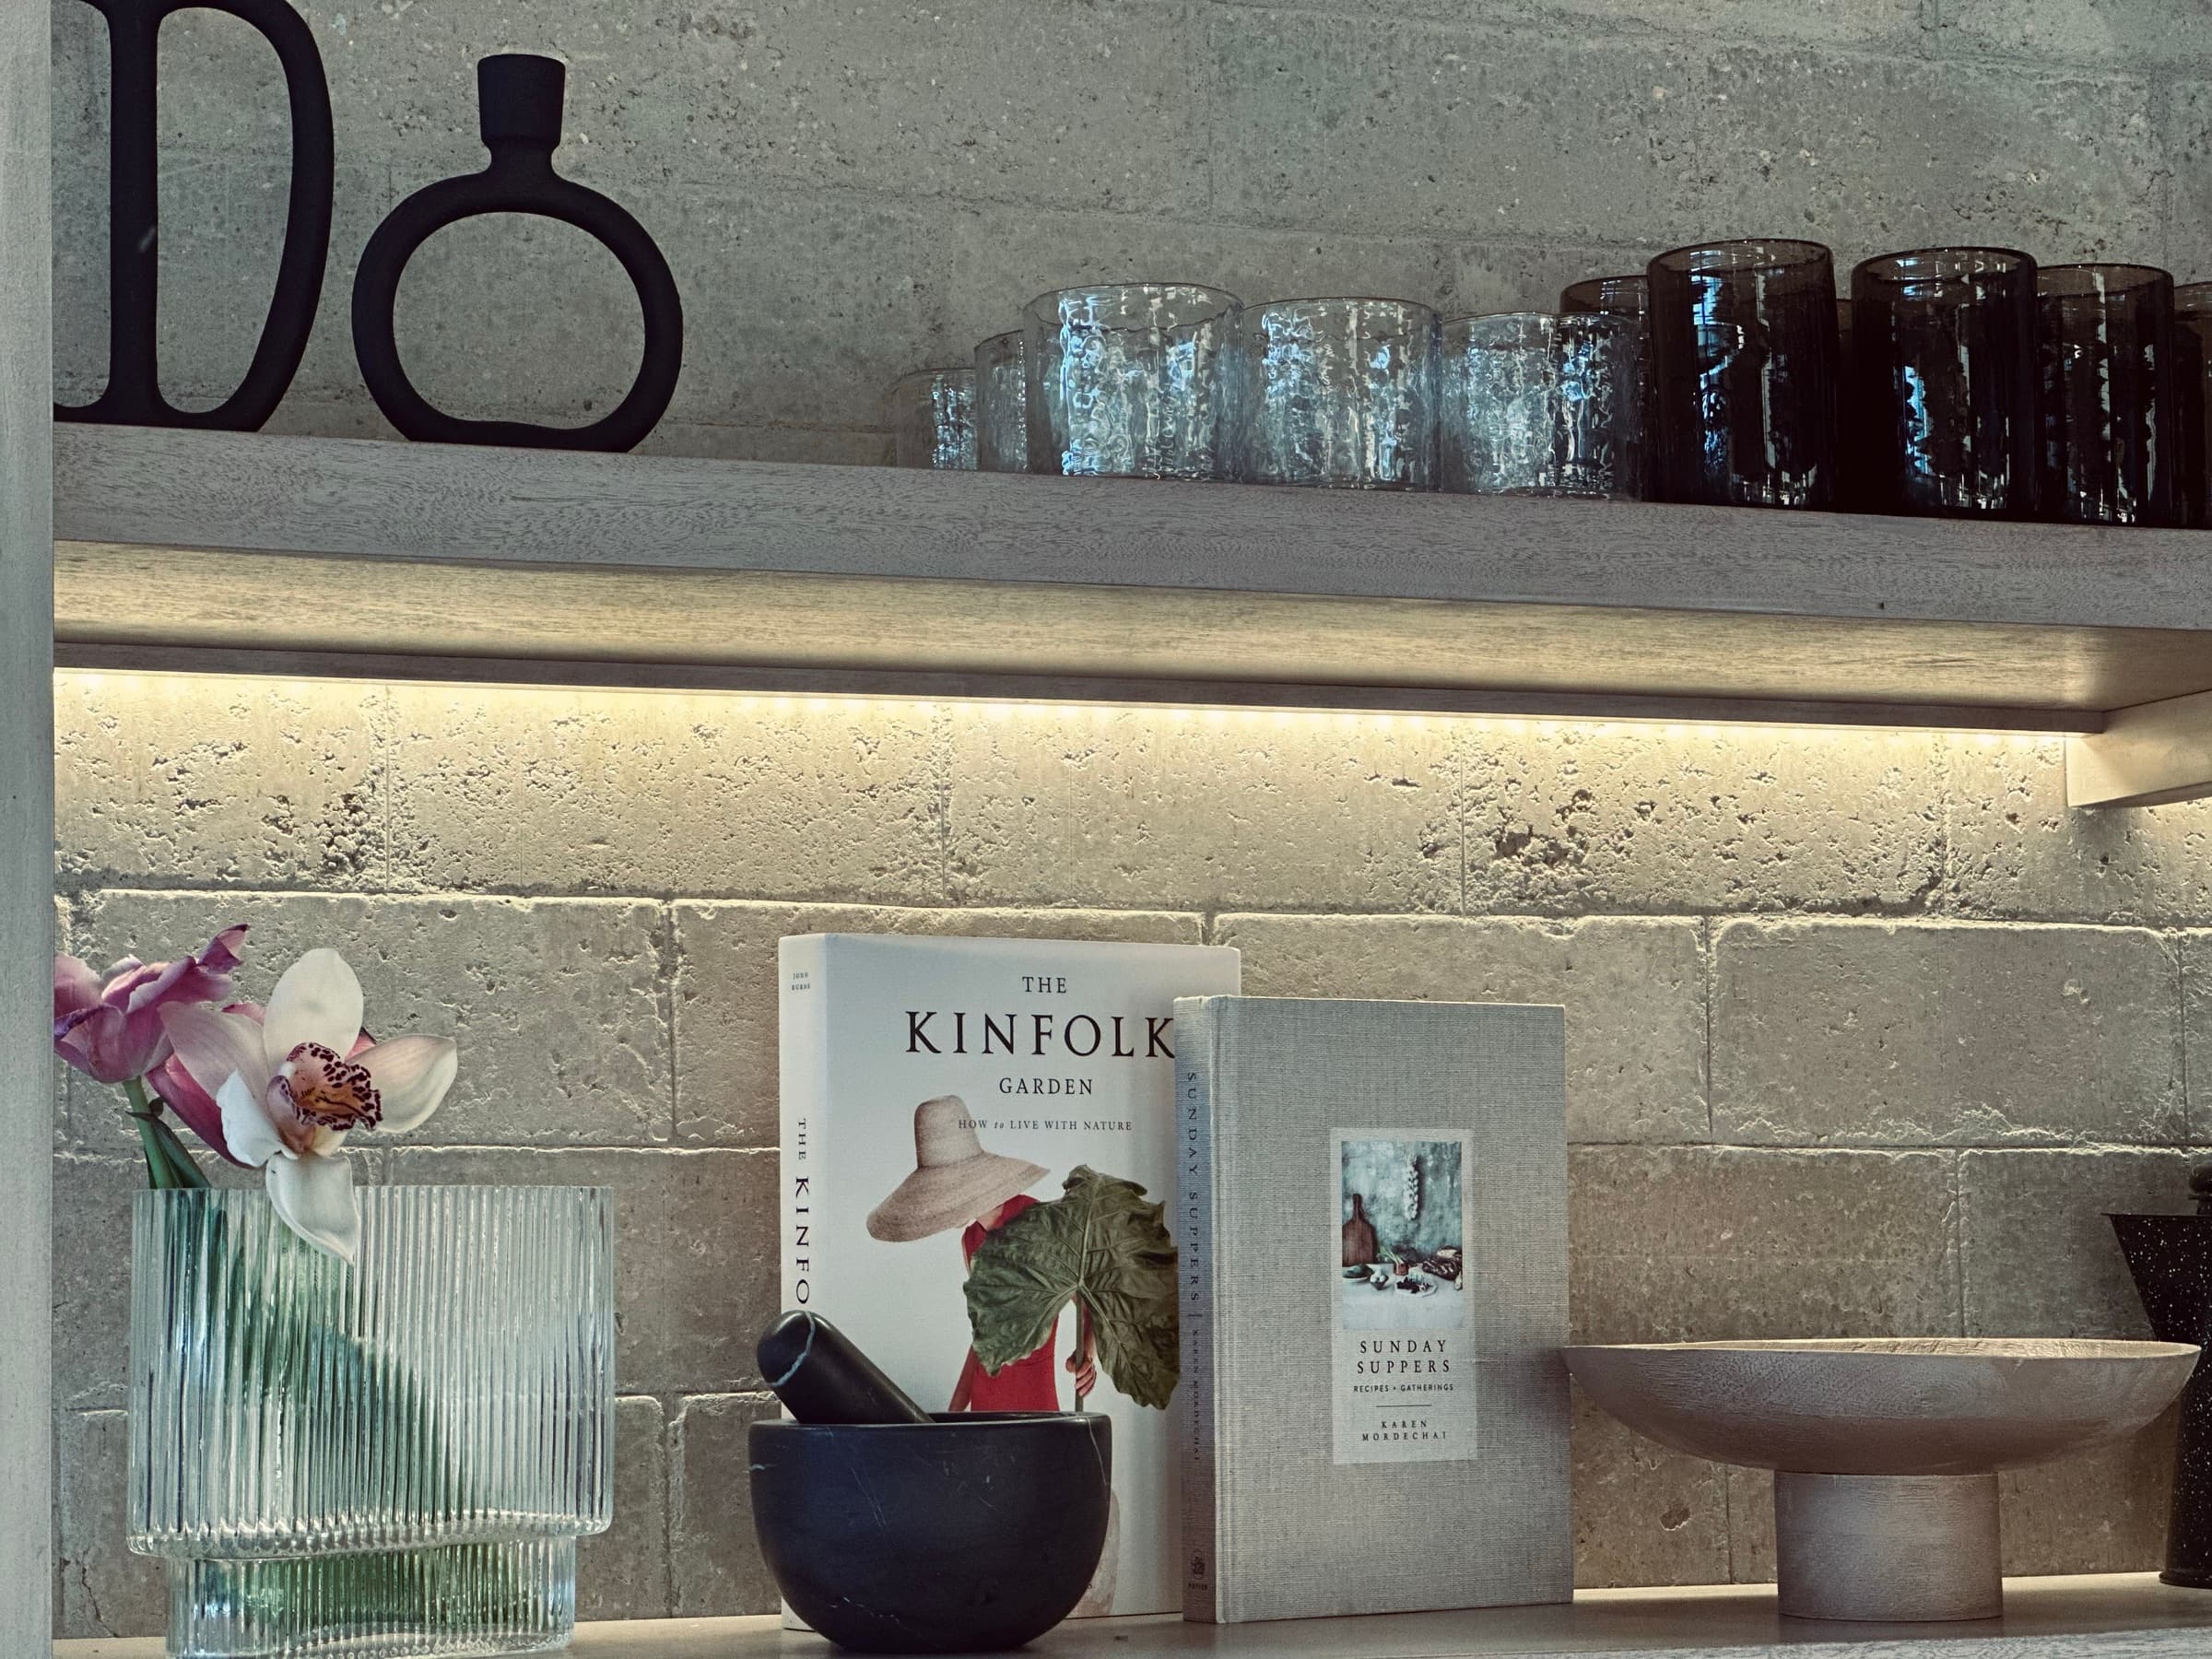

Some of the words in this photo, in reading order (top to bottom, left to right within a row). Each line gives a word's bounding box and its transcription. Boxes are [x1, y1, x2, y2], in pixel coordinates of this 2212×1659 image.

[1022, 976, 1067, 994] THE
[905, 1010, 1176, 1059] KINFOLK
[999, 1077, 1094, 1096] GARDEN
[959, 1119, 988, 1130] HOW
[994, 1120, 1005, 1130] to
[1010, 1120, 1040, 1131] LIVE
[1045, 1120, 1077, 1131] WITH
[1083, 1120, 1134, 1132] NATURE
[1187, 1071, 1198, 1175] SUNDAY
[798, 1118, 806, 1160] THE
[795, 1176, 810, 1305] KINFO
[1189, 1192, 1200, 1301] SUPPERS
[1359, 1339, 1447, 1354] SUNDAY
[1357, 1359, 1450, 1374] SUPPERS
[1353, 1384, 1389, 1393] RECIPES
[1400, 1383, 1454, 1392] GATHERINGS
[1381, 1419, 1428, 1429] KAREN
[1361, 1431, 1447, 1441] MORDECHAI
